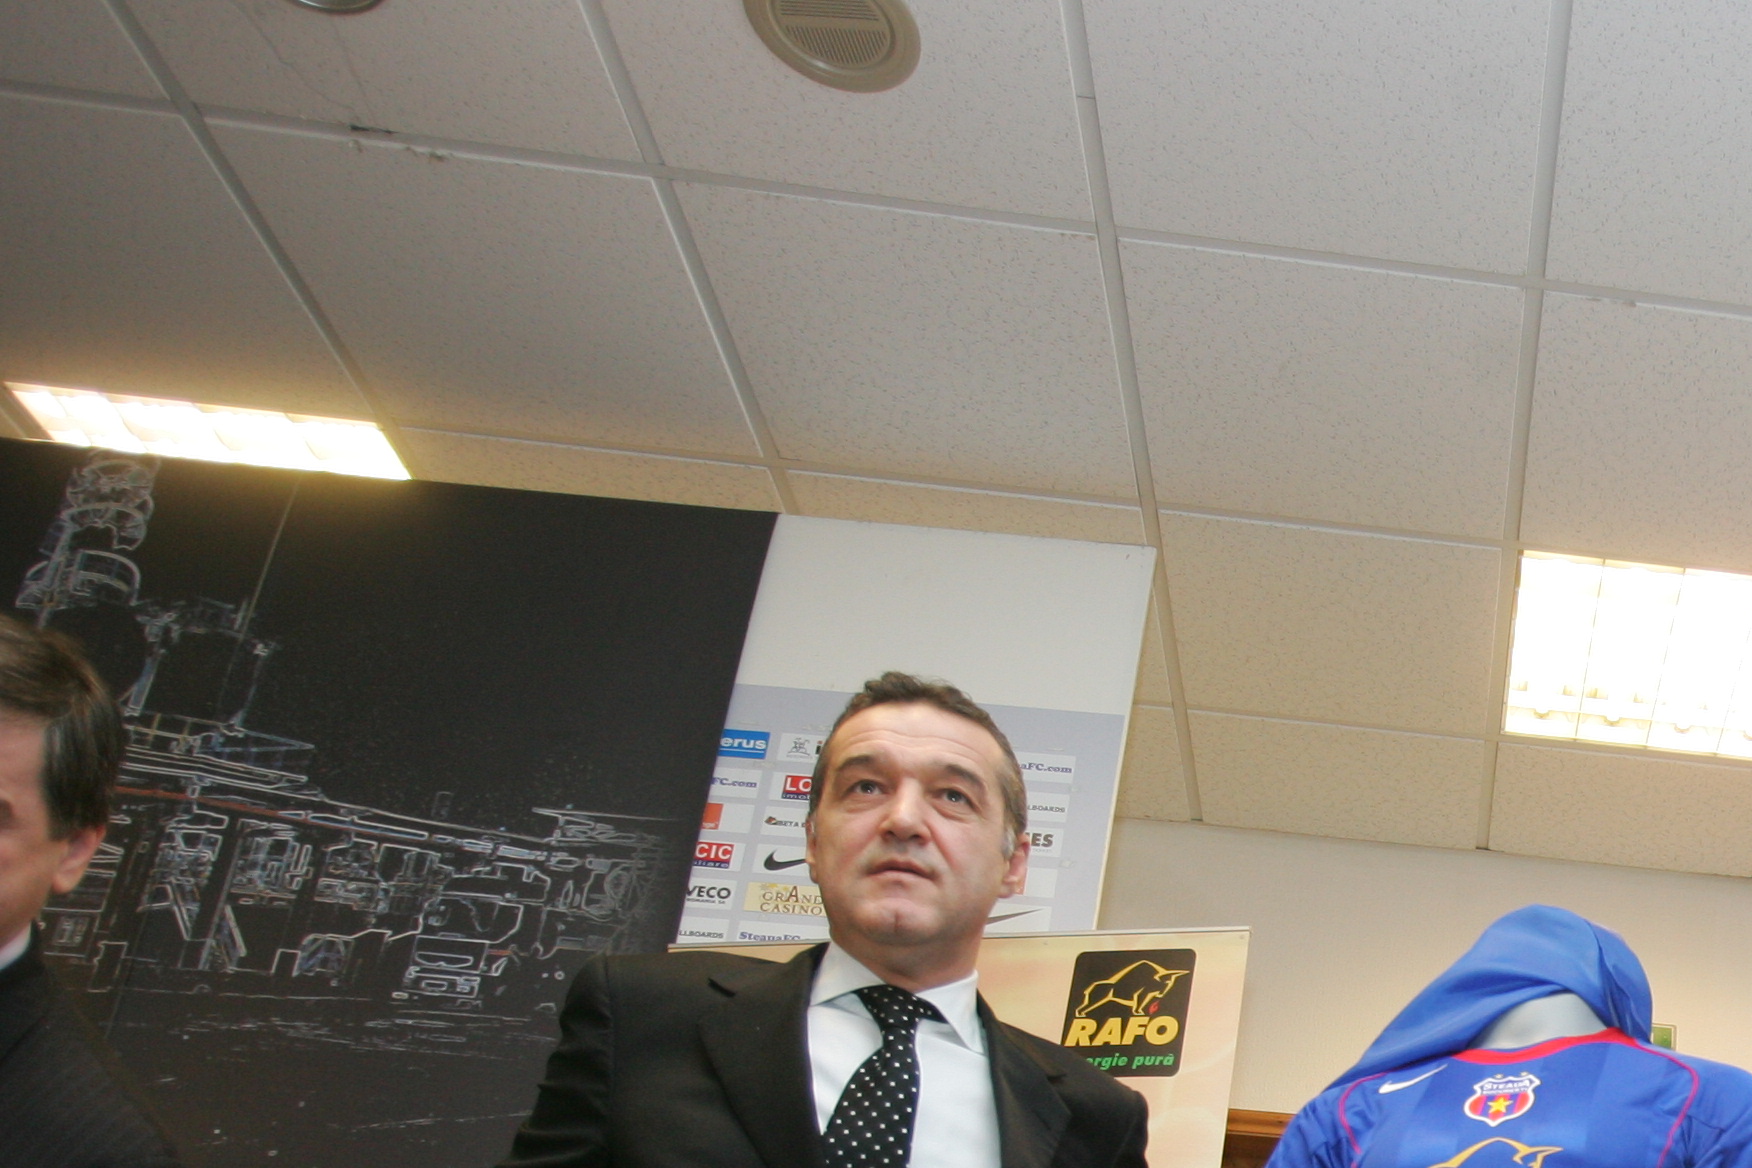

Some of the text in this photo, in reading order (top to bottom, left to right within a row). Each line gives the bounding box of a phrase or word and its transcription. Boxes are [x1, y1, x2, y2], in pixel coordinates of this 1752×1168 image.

[720, 737, 767, 750] erus
[762, 885, 823, 905] GRAND
[760, 902, 823, 916] CASINO
[1064, 1015, 1179, 1047] RAFO
